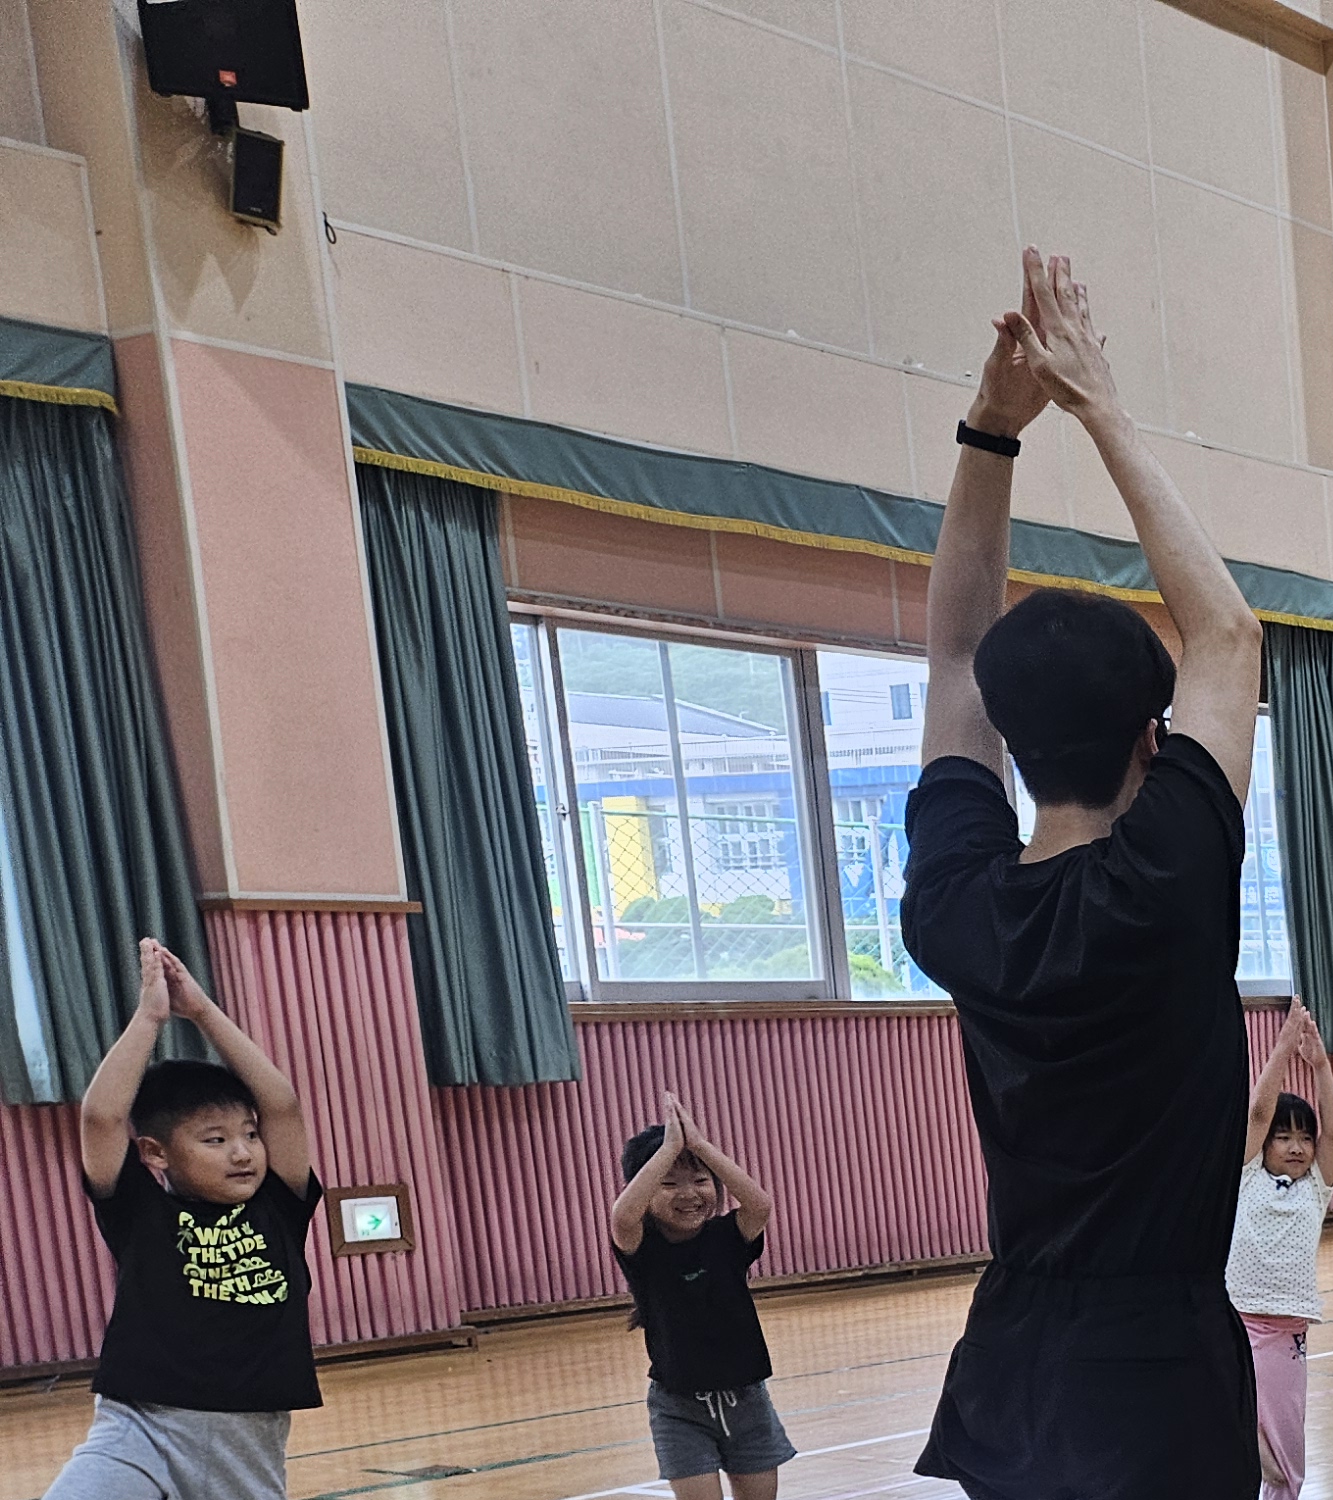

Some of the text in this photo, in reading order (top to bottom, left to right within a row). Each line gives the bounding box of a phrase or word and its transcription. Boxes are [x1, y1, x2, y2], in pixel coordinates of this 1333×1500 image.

[188, 1233, 268, 1264] THE TIDE
[189, 1278, 232, 1302] THE
